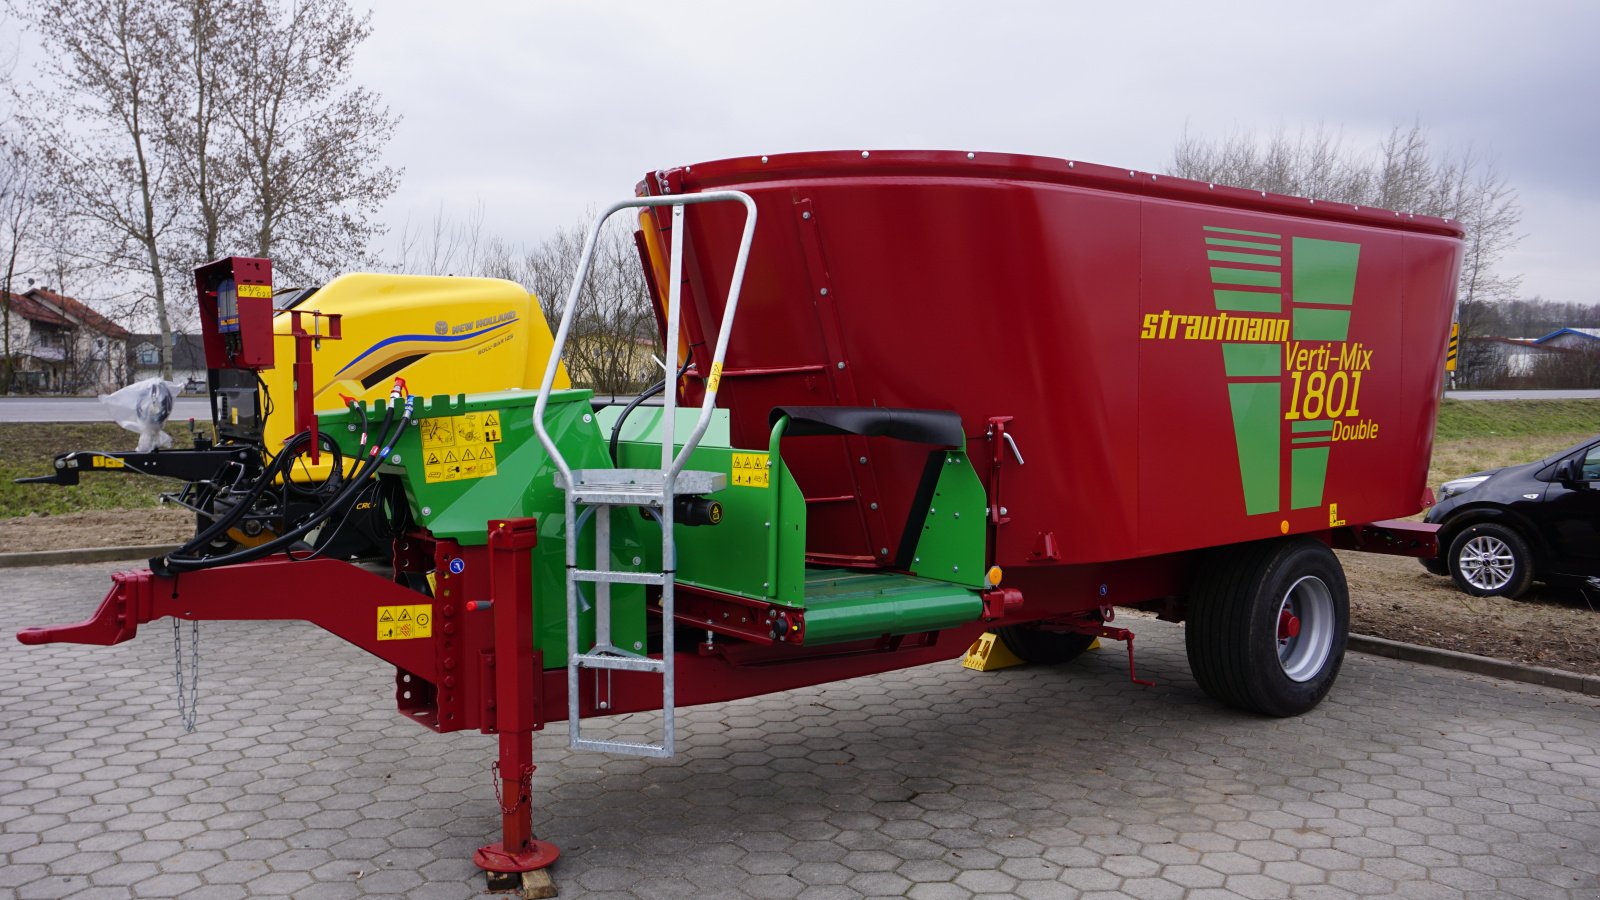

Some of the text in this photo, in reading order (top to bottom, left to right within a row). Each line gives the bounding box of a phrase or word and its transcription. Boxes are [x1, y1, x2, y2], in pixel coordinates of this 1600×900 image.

[452, 310, 517, 335] NEW HOLLAND
[1140, 310, 1290, 342] strautmann
[1285, 341, 1374, 371] Verti-Mix
[1285, 371, 1362, 420] 1801
[1331, 419, 1379, 442] Double
